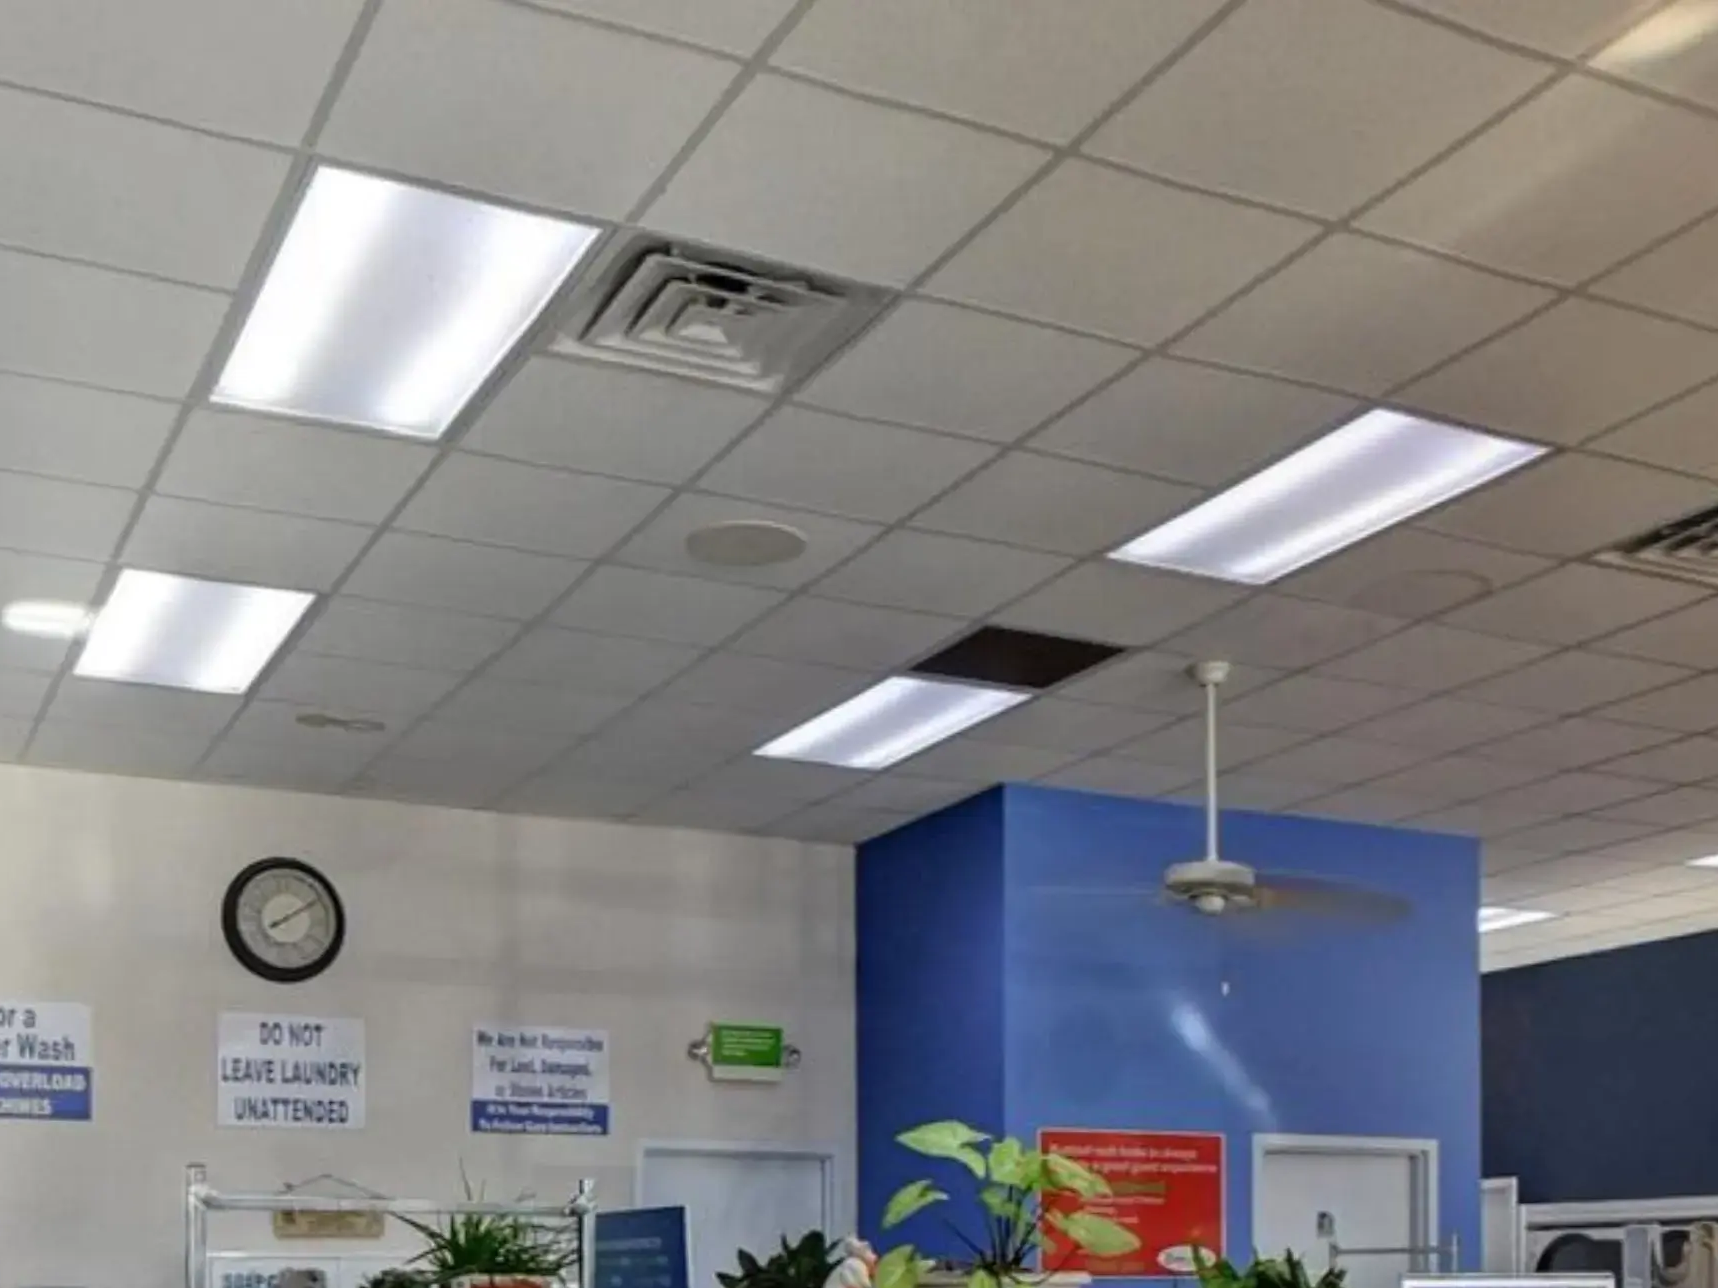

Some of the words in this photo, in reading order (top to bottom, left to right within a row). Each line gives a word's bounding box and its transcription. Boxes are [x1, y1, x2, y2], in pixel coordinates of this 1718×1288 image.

[22, 1007, 37, 1028] a
[16, 1032, 75, 1061] Wash
[259, 1022, 282, 1045] DO
[288, 1023, 324, 1047] NOT
[221, 1057, 274, 1083] LEAVE
[281, 1060, 360, 1086] LAUNDRY
[234, 1097, 349, 1123] UNATTENDED
